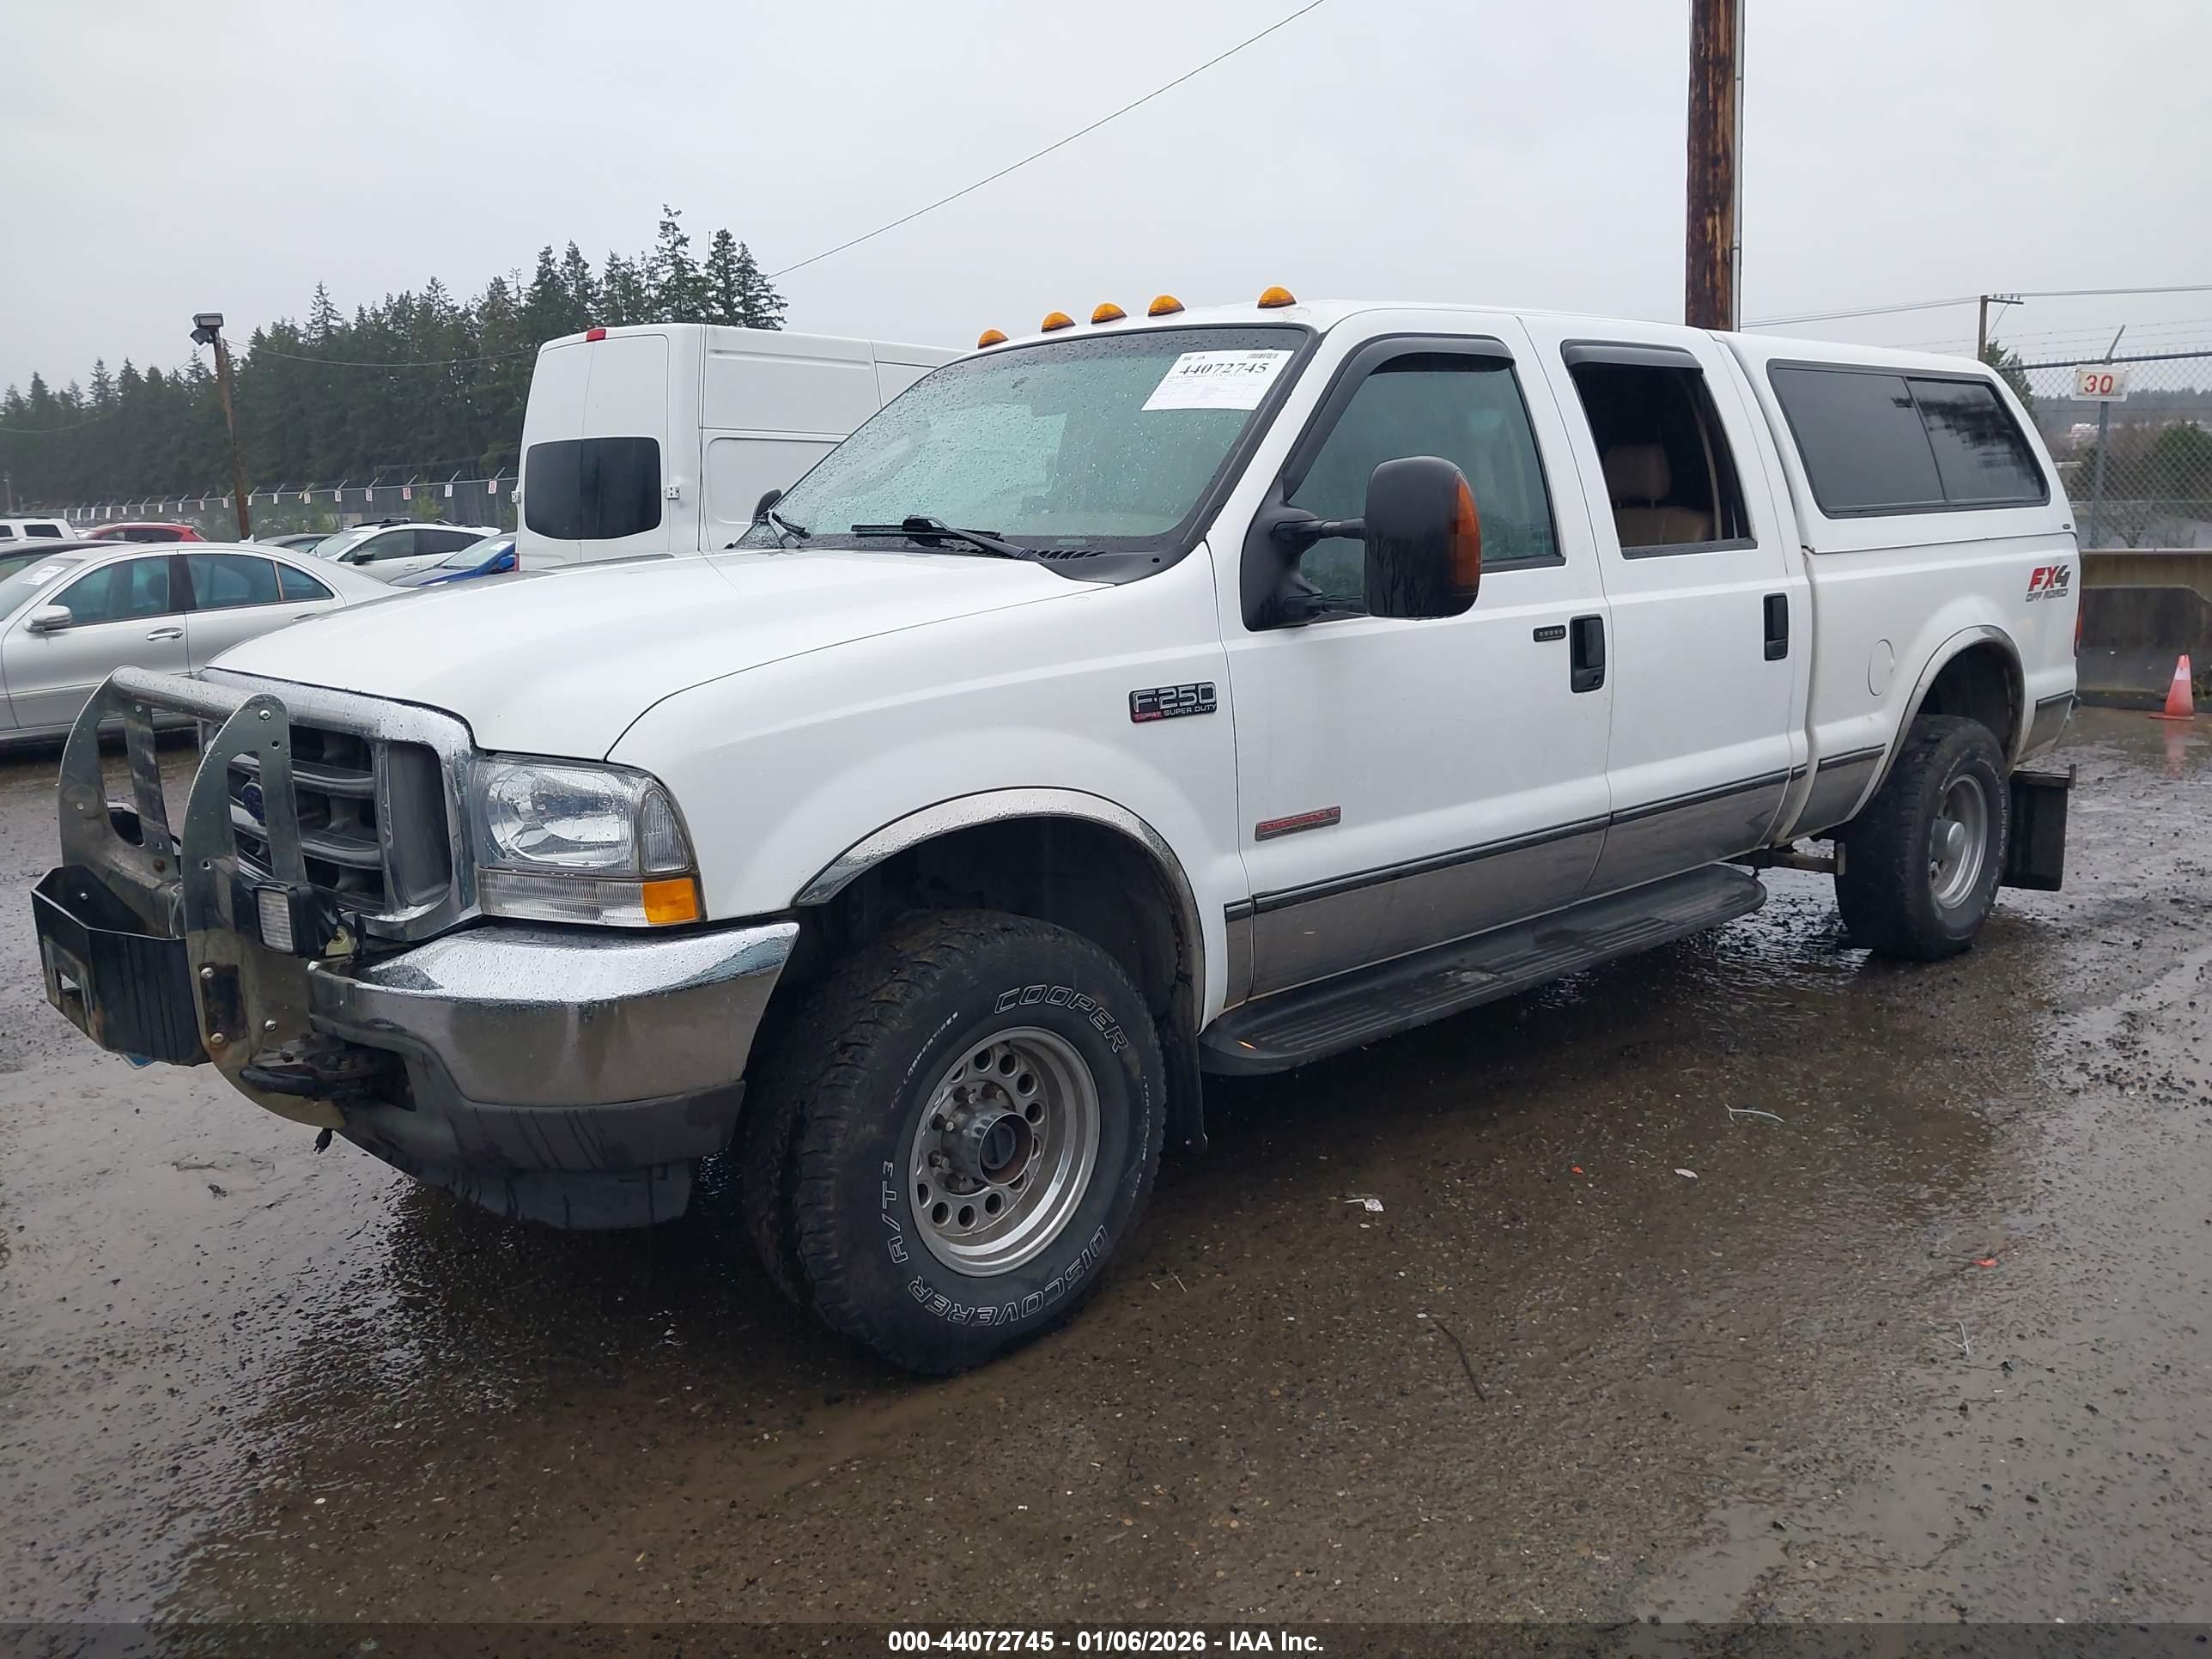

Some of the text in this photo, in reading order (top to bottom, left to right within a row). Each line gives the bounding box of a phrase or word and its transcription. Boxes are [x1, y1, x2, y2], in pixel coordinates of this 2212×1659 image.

[1179, 362, 1269, 375] 44072745
[2084, 374, 2113, 394] 30
[2027, 564, 2071, 592] FX4
[1164, 707, 1192, 716] SUPER
[1194, 703, 1217, 712] DUTY
[994, 984, 1129, 1054] COOPER
[907, 1224, 1109, 1328] DISCOVERER
